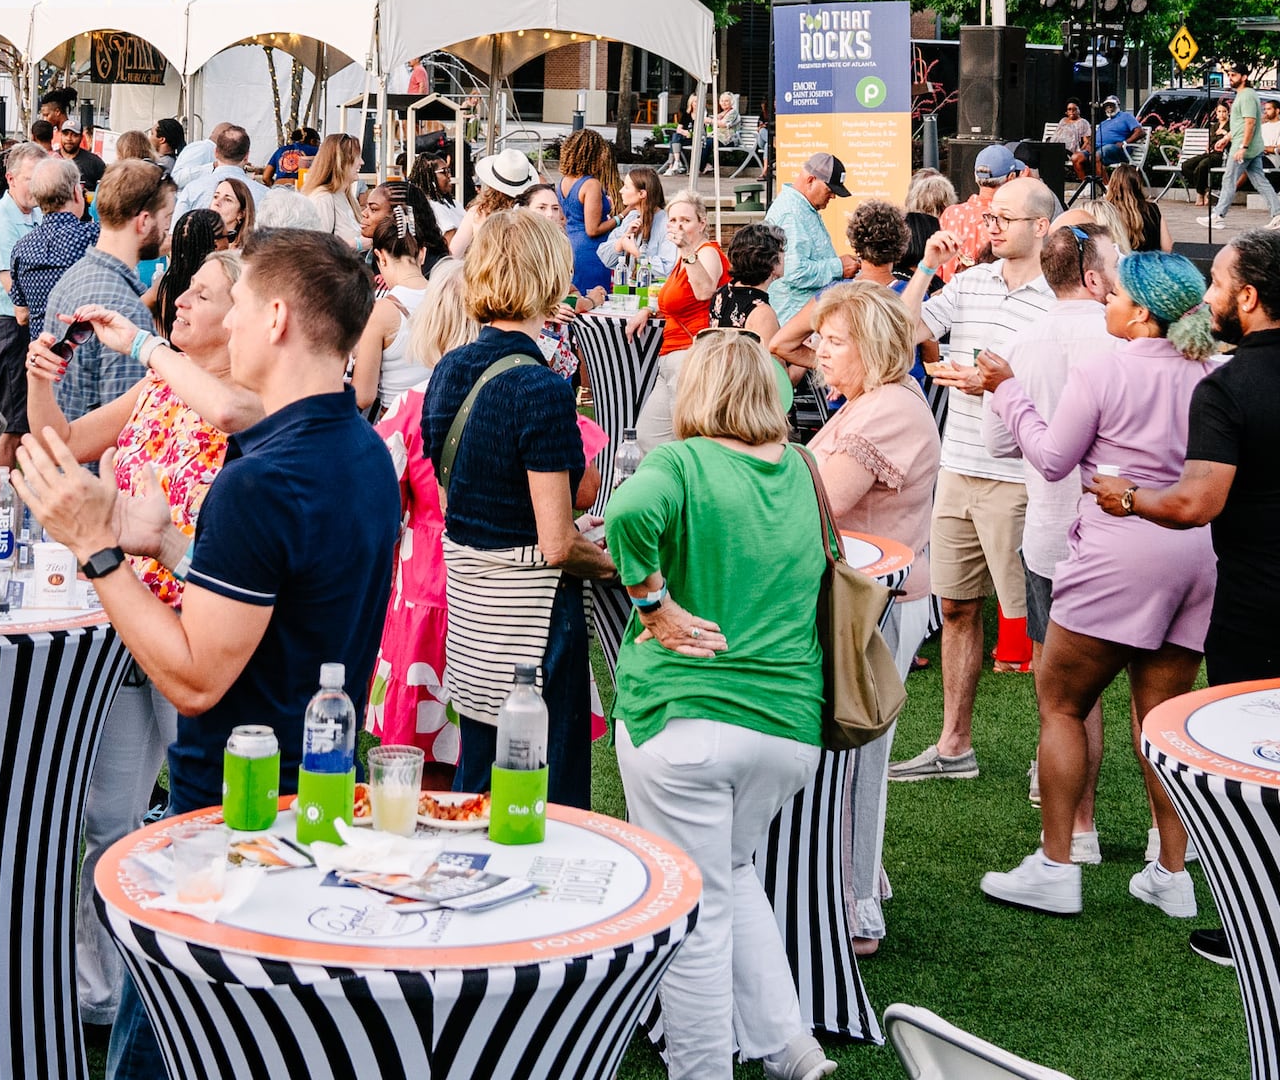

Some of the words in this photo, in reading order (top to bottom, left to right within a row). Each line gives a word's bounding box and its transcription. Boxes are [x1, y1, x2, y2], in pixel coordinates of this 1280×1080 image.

[831, 9, 871, 30] THAT
[800, 30, 872, 61] ROCKS
[793, 81, 817, 91] EMORY
[793, 98, 819, 106] HOSPITAL
[508, 804, 529, 814] Club
[531, 927, 598, 951] FOUR
[598, 897, 674, 936] ULTIMATE
